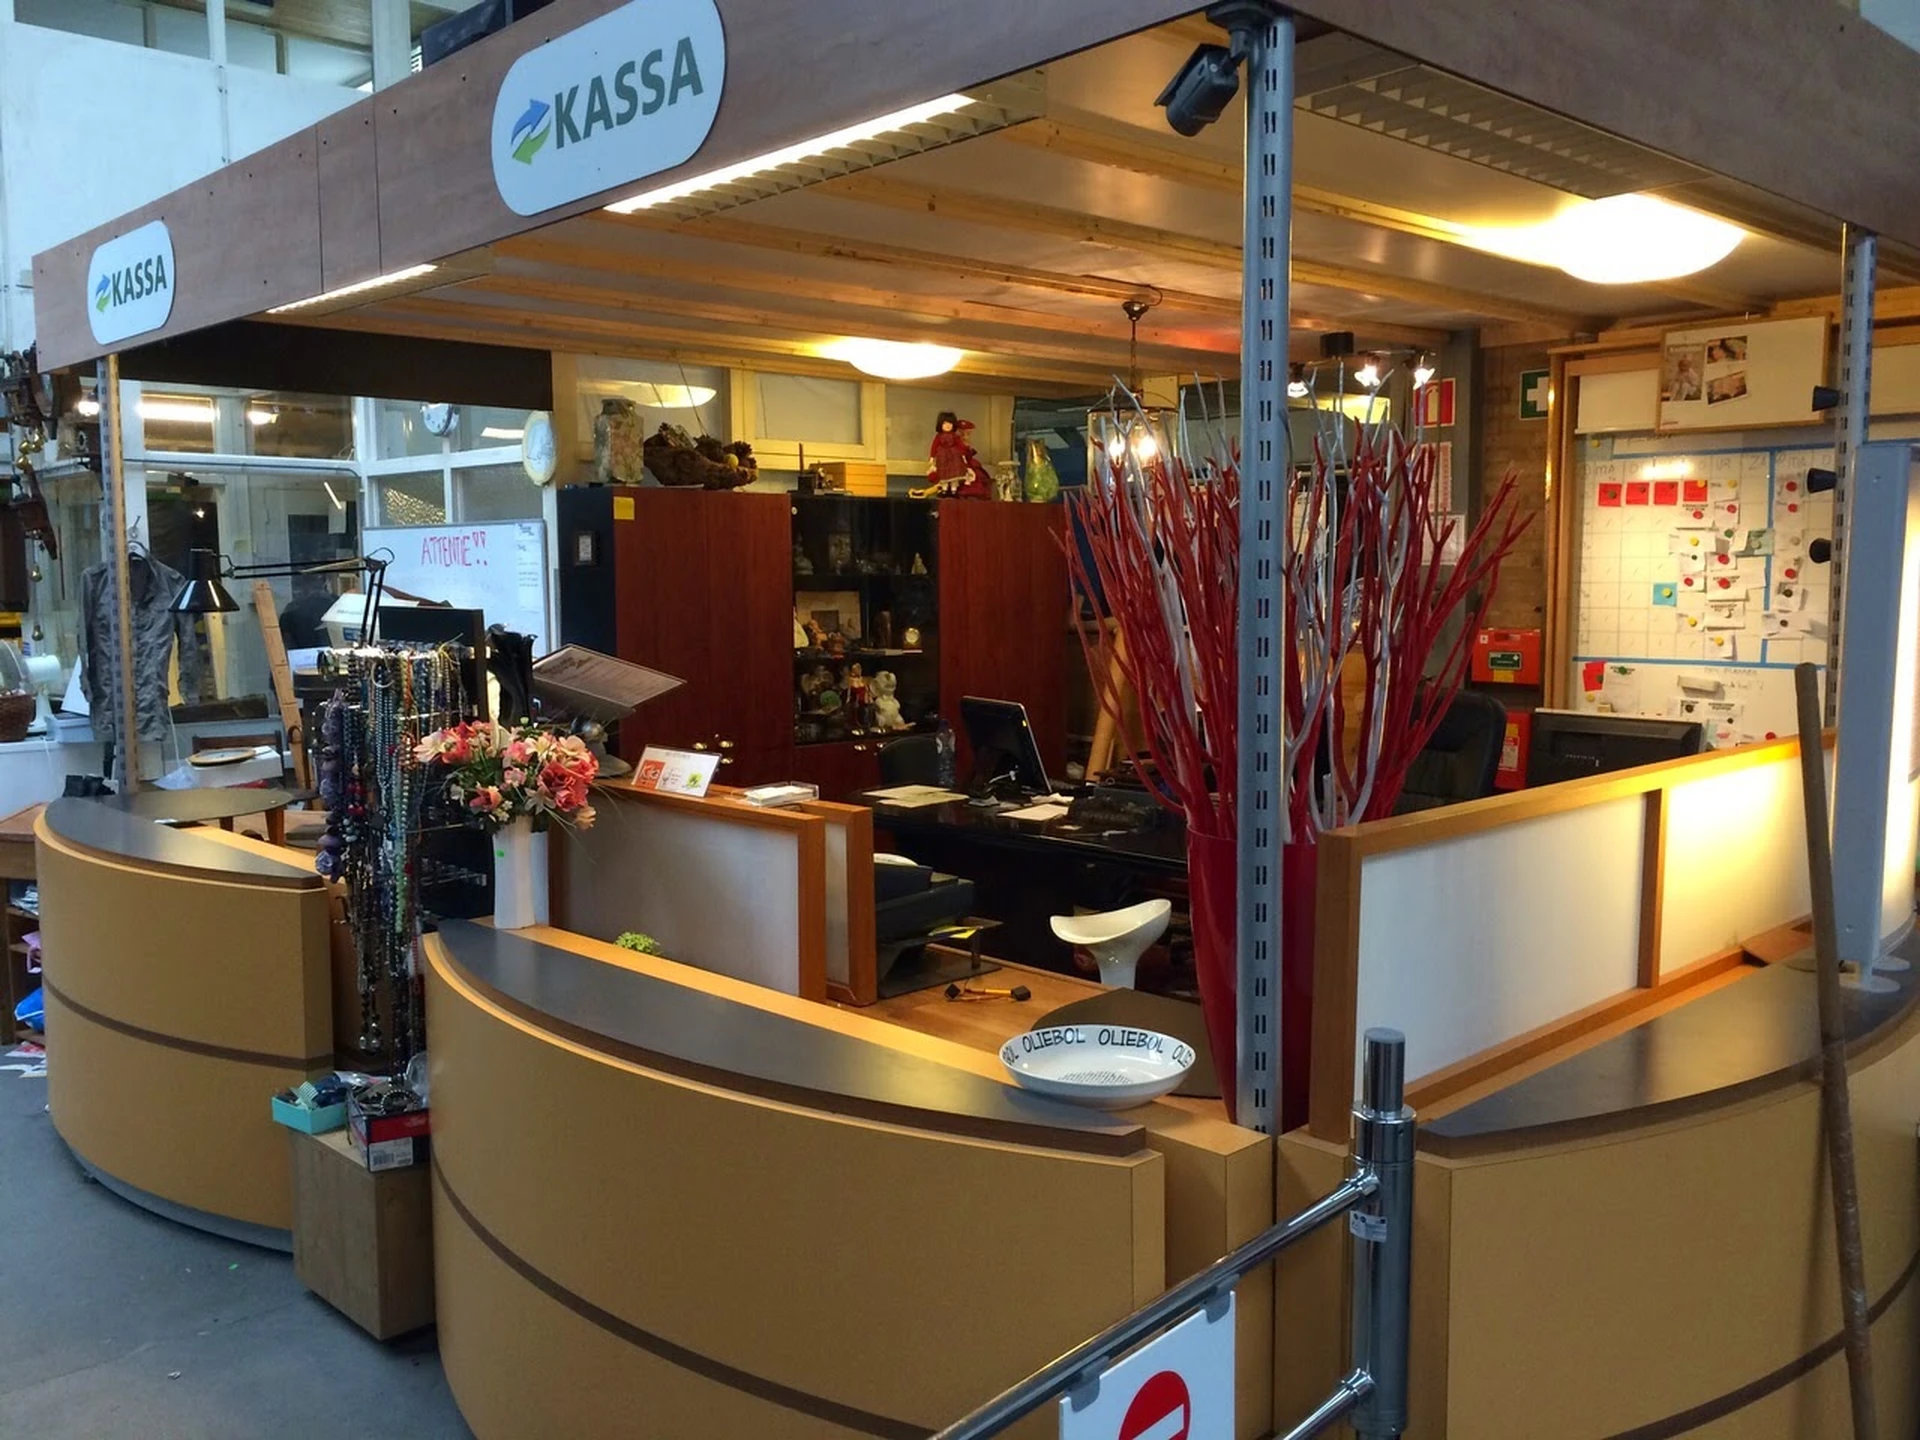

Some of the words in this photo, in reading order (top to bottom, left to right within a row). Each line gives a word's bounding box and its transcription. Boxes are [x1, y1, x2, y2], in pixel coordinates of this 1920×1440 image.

[555, 36, 704, 150] KASSA
[112, 254, 167, 307] KASSA
[421, 531, 488, 567] ATTENTIE!!
[1022, 1027, 1086, 1053] OLIEBOL
[1098, 1028, 1164, 1054] OLIEBOL
